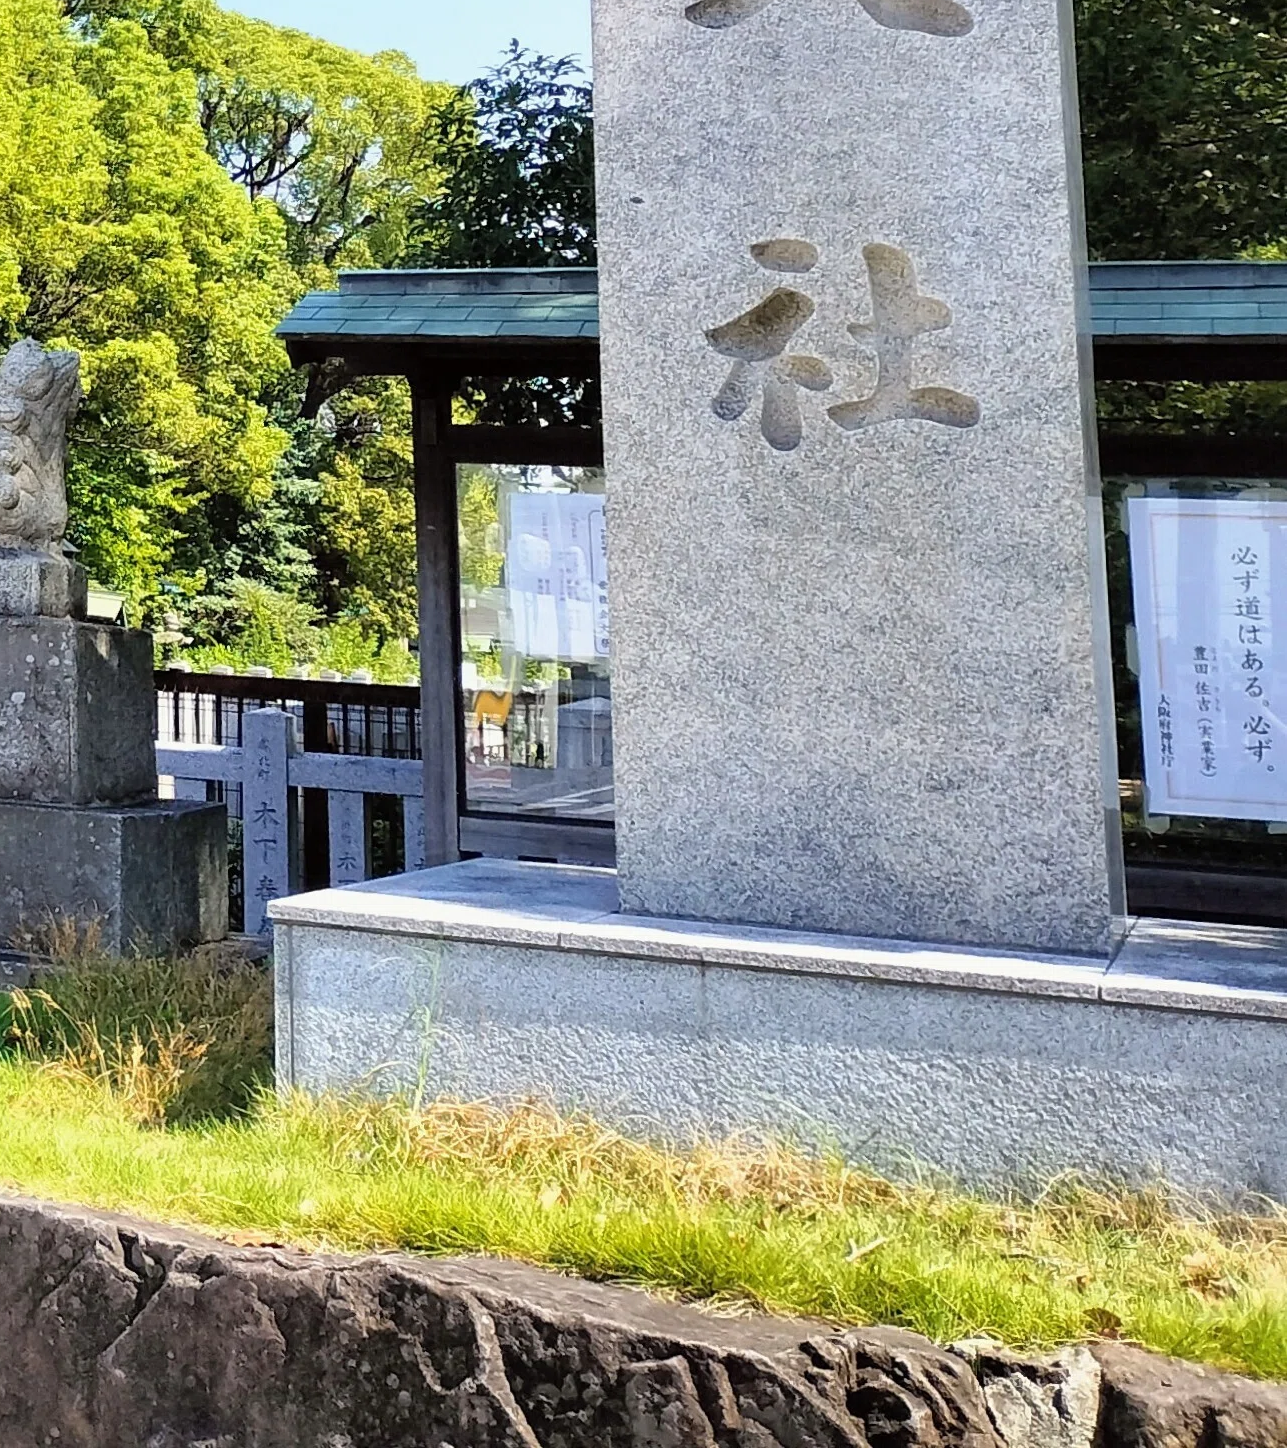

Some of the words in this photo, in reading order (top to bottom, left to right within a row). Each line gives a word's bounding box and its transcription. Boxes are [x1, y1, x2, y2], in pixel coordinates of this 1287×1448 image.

[1231, 545, 1275, 773] 必ず道はある。必ず。
